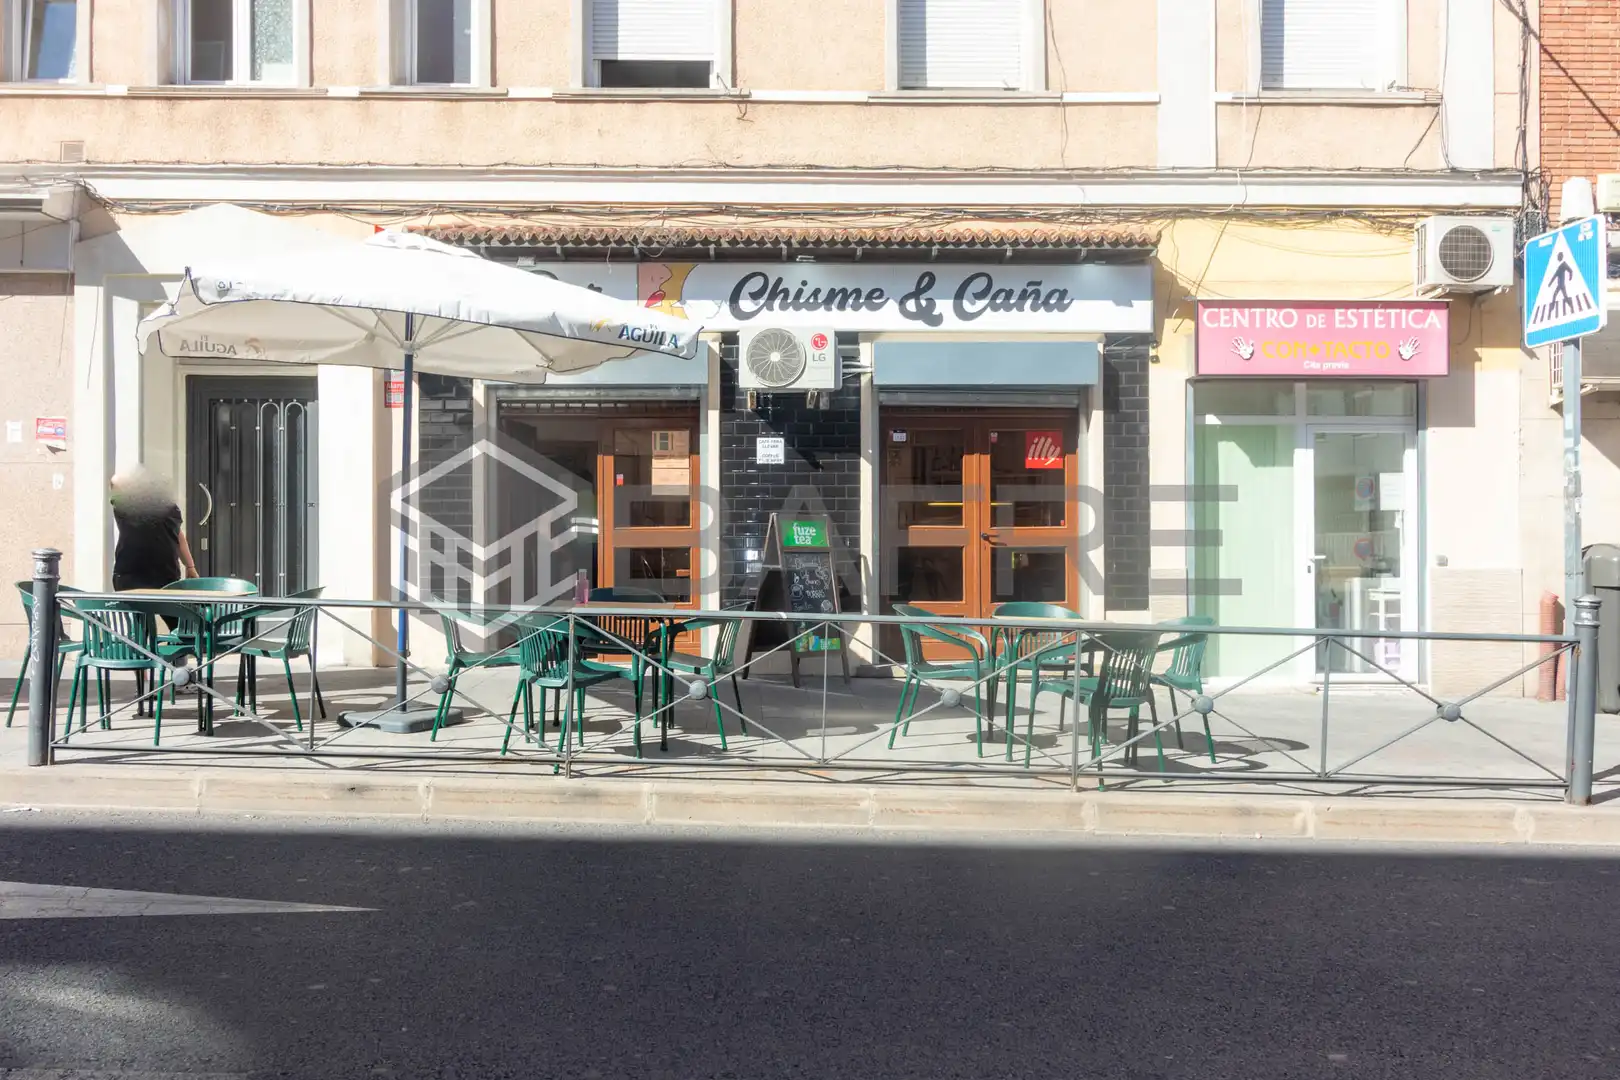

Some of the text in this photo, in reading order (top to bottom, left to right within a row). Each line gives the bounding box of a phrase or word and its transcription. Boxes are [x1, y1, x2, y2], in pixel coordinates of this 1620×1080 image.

[729, 271, 1075, 327] Chisme & Caña
[1202, 304, 1442, 329] CENTRO DE ESTÉTICA
[811, 352, 827, 362] LG
[1303, 360, 1321, 370] Cita
[1028, 436, 1061, 466] illy
[792, 522, 816, 536] fuze
[793, 534, 812, 545] tea
